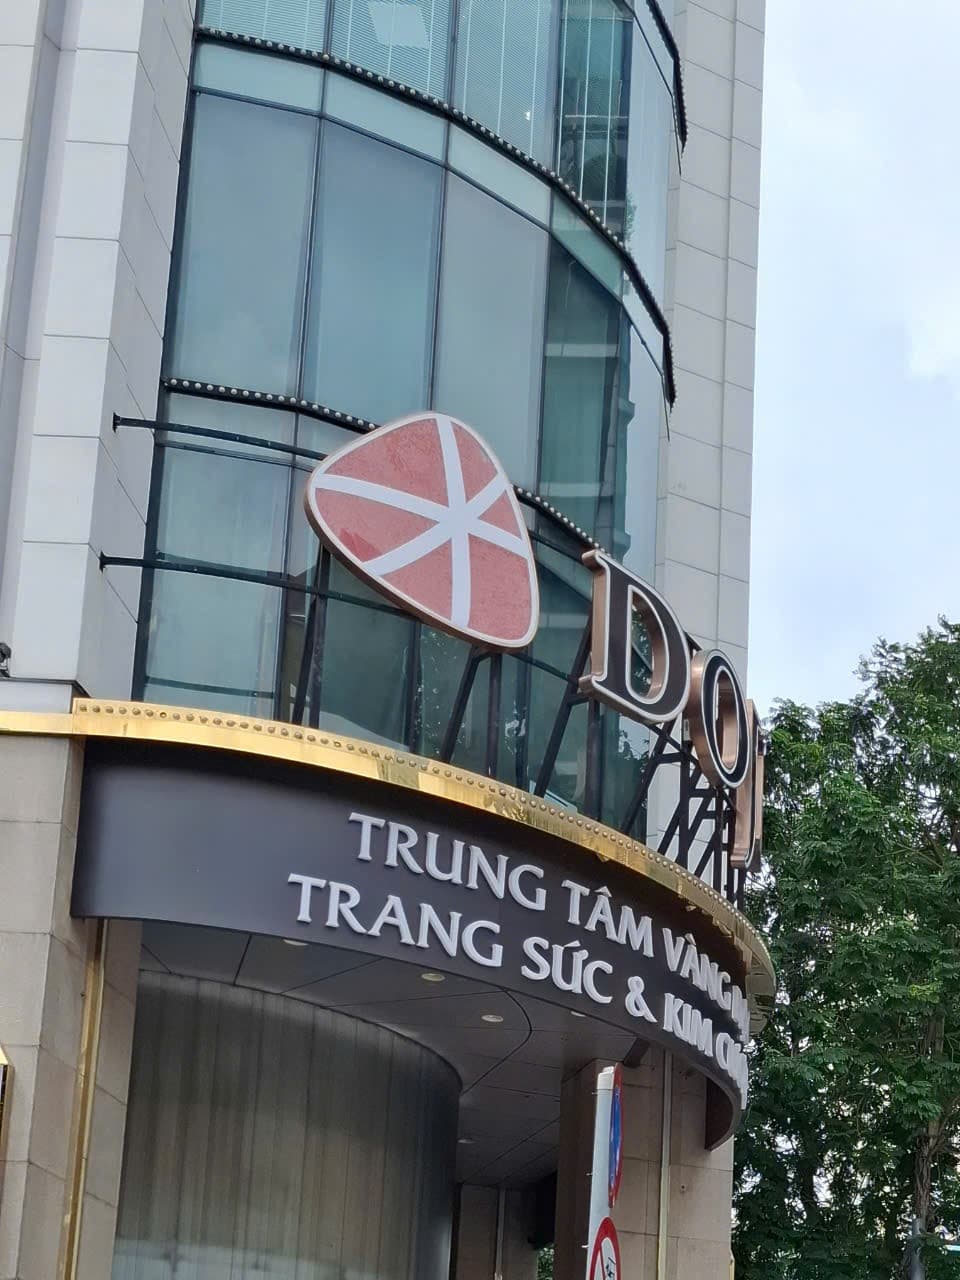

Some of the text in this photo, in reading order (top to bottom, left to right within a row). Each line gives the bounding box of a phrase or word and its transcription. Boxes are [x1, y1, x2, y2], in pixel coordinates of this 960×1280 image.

[287, 873, 503, 967] TRANG
[521, 936, 613, 1004] SỨC
[625, 976, 657, 1023] &
[663, 993, 713, 1057] KIM
[348, 812, 732, 1011] TRUNG TÂM VÀNG
